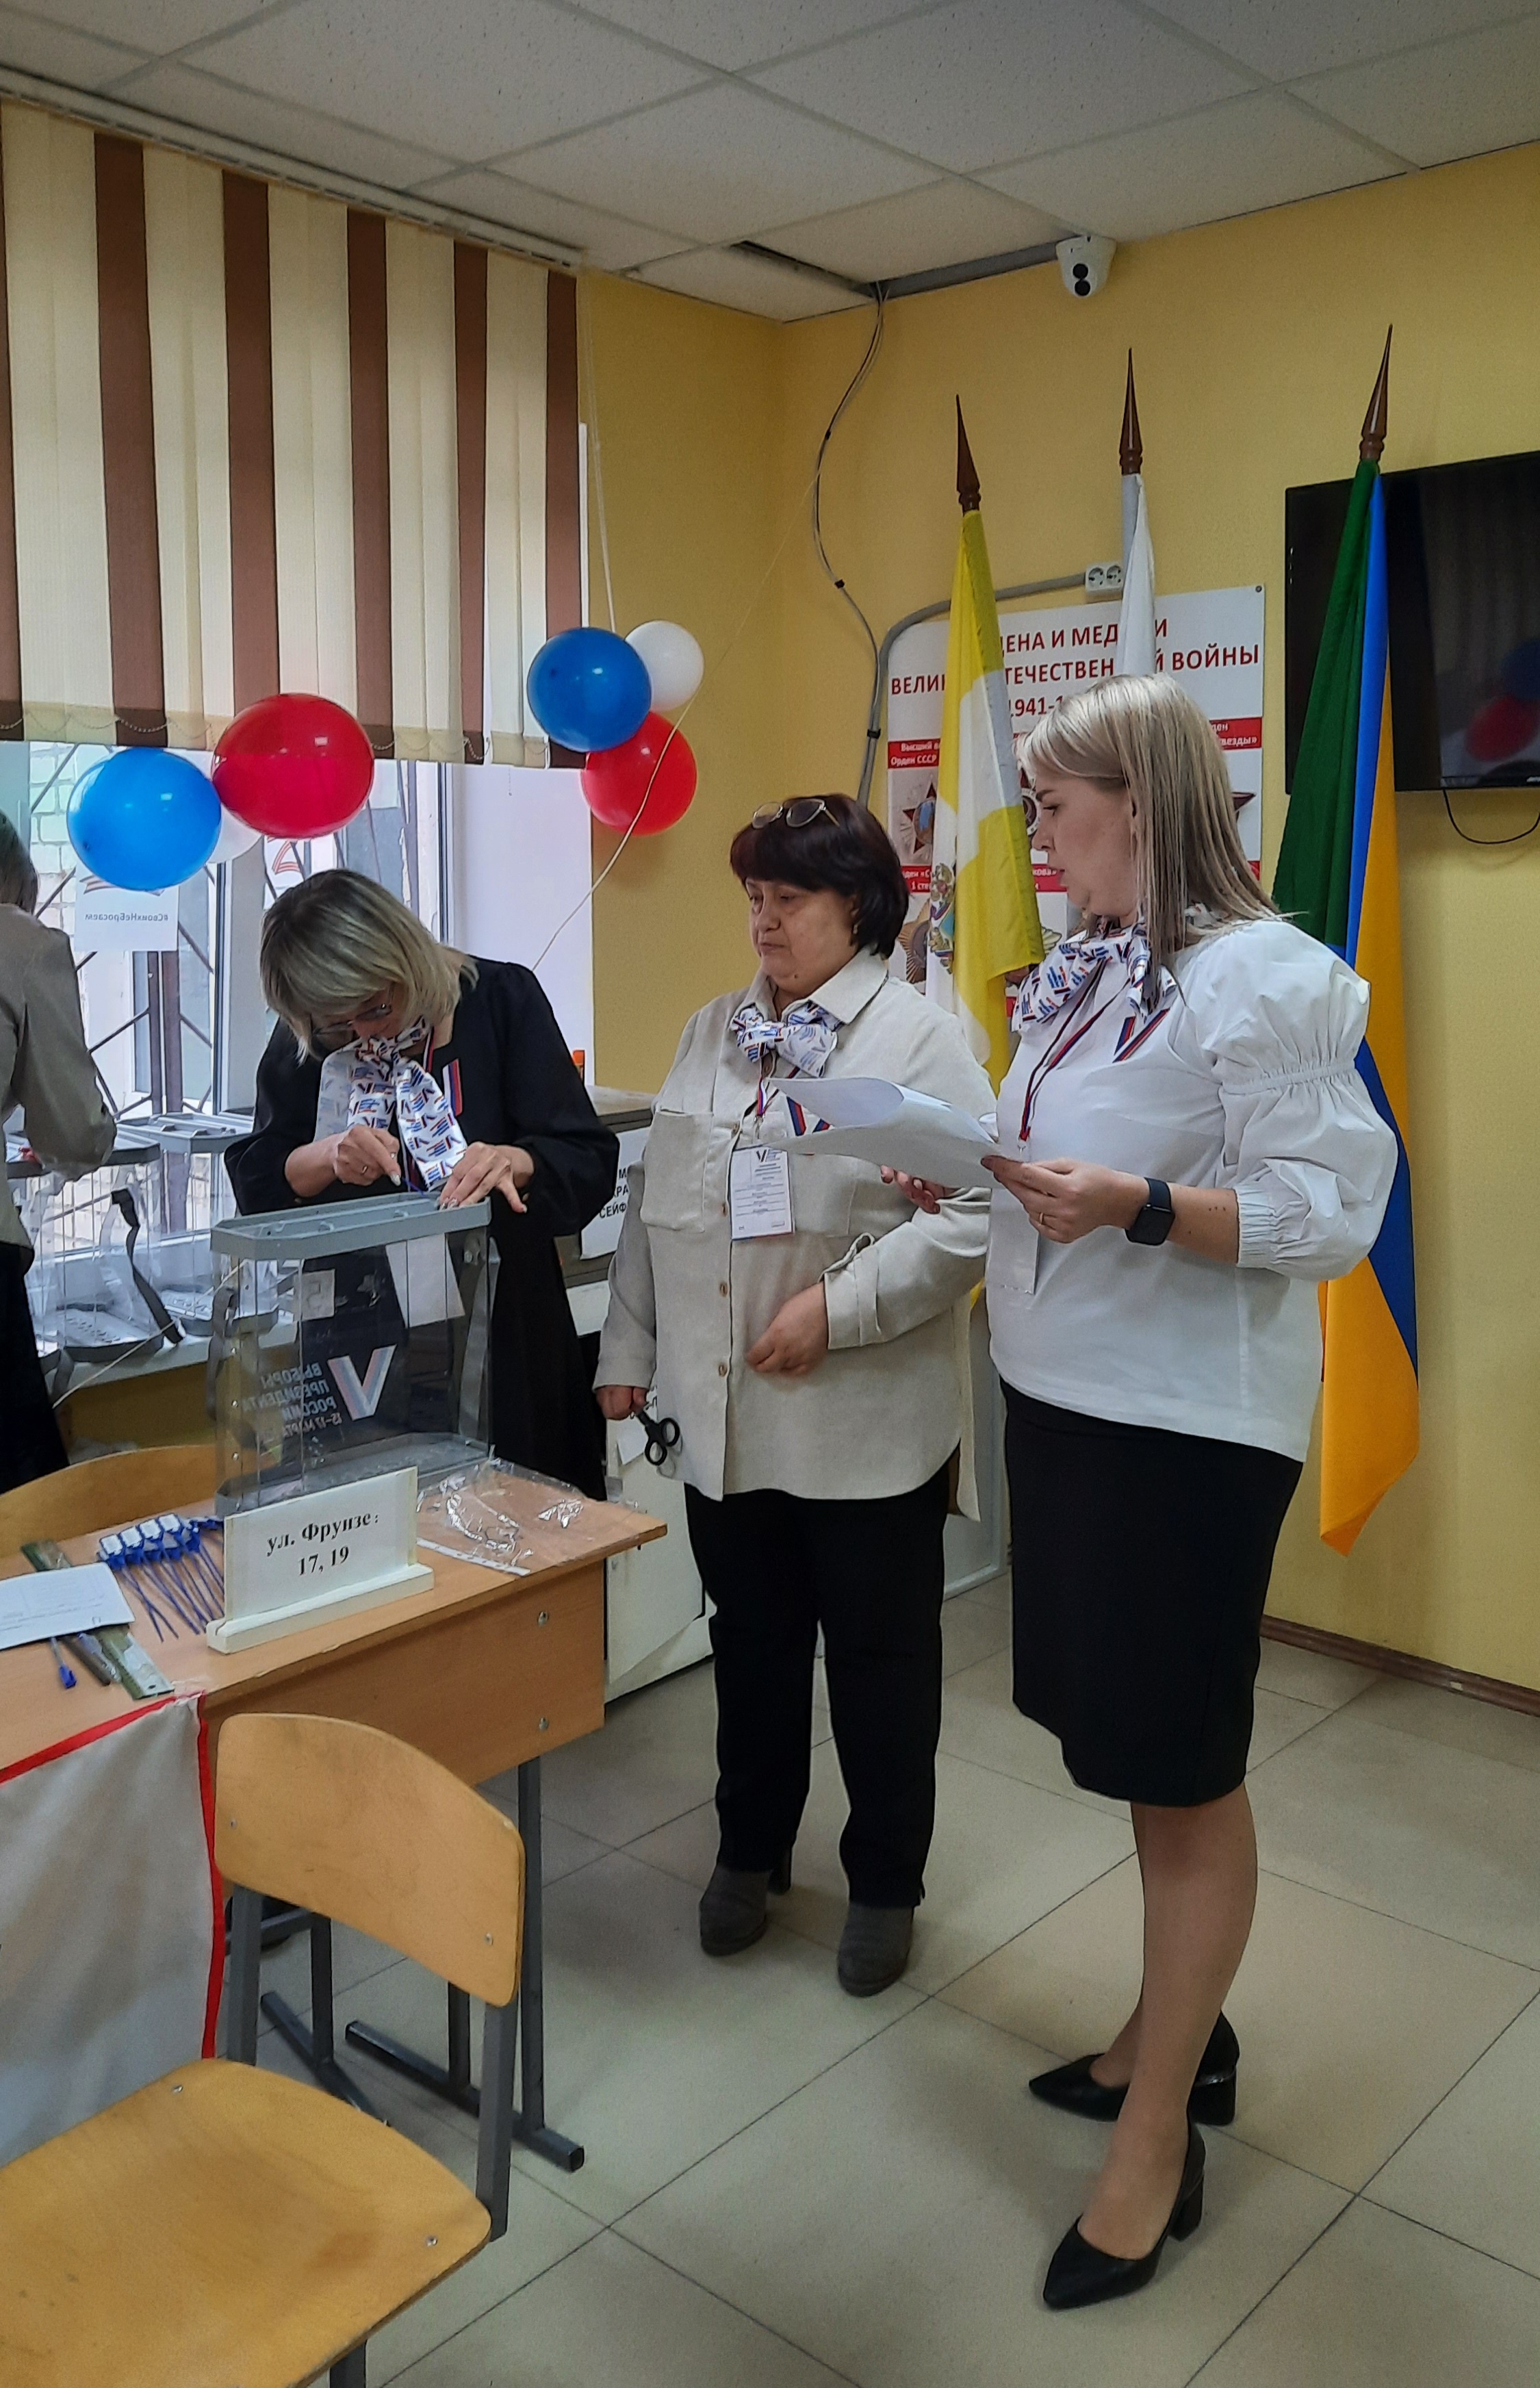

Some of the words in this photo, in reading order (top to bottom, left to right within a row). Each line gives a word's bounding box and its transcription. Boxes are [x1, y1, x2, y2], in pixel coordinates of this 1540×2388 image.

[1051, 629, 1065, 649] И
[891, 673, 945, 695] ВЕЛИ
[1172, 643, 1259, 671] ВОЙНЫ
[1220, 736, 1257, 747] везды»
[890, 756, 916, 767] Орден
[917, 754, 937, 765] СССР
[267, 1533, 295, 1557] ул.
[298, 1553, 324, 1576] 17,
[331, 1545, 349, 1567] 19
